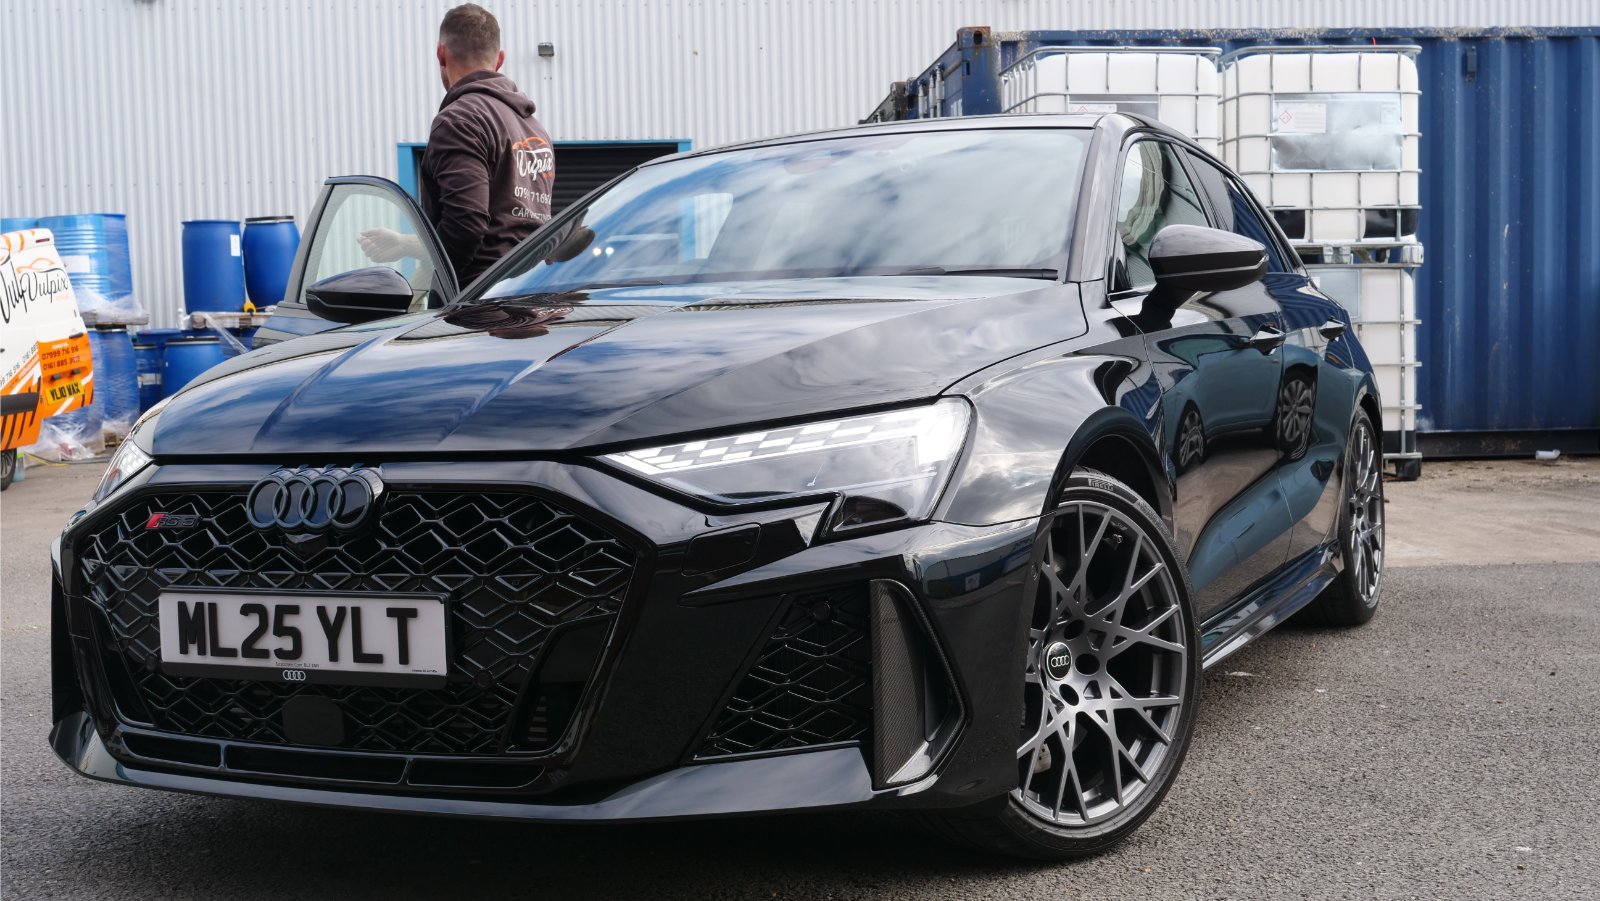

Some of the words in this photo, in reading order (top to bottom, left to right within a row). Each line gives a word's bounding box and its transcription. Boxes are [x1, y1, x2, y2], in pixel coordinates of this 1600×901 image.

[20, 270, 68, 304] Vulpix
[41, 350, 61, 360] 07999
[62, 347, 70, 355] 716
[70, 345, 79, 353] 916
[43, 362, 56, 371] 0161
[1088, 478, 1114, 492] PIRELLI
[177, 601, 303, 660] ML25
[316, 606, 418, 665] YLT
